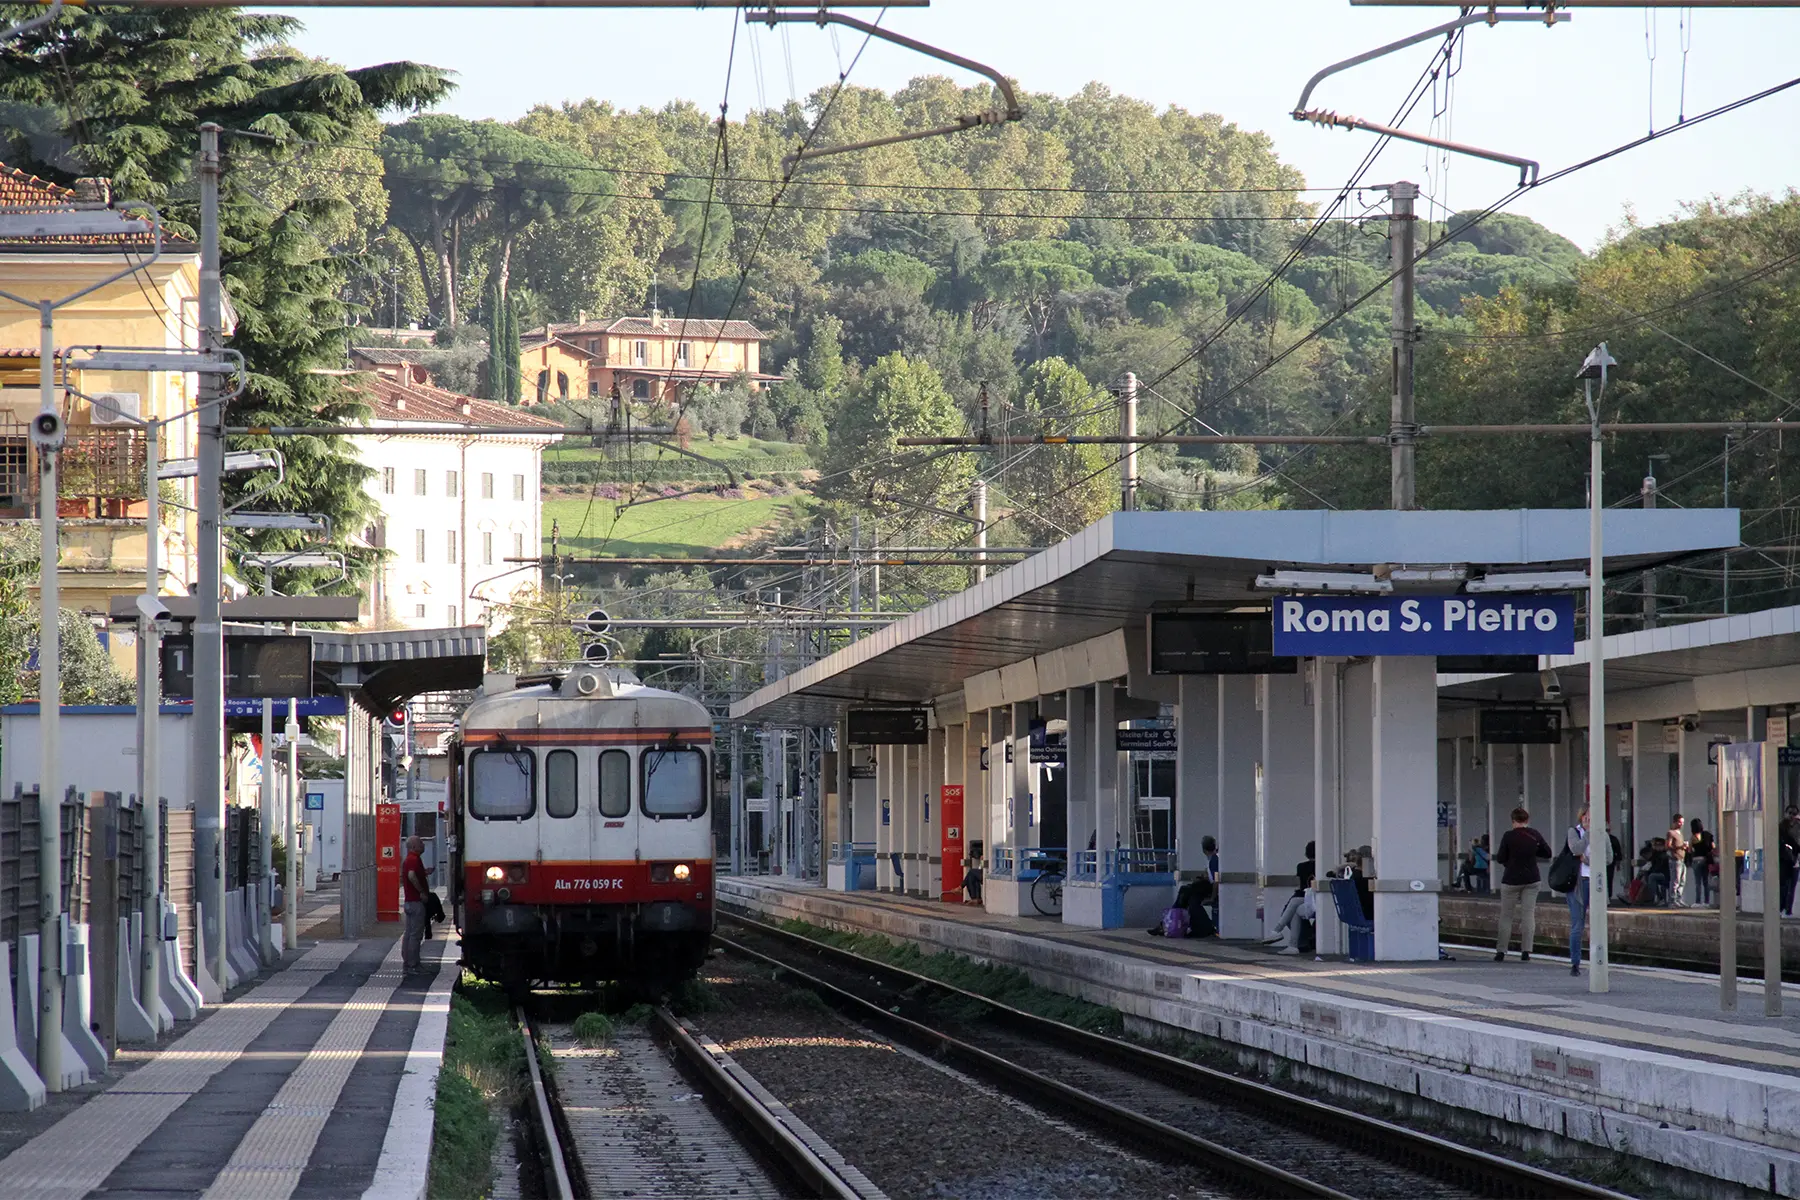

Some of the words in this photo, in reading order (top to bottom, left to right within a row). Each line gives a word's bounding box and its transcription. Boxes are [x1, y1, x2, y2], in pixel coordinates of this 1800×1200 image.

[1282, 601, 1390, 632] Roma
[1400, 600, 1432, 632] S.
[1444, 599, 1558, 632] Pietro
[173, 650, 184, 671] 1
[914, 719, 924, 731] 2
[944, 788, 961, 796] SOS
[380, 807, 396, 815] SOS
[554, 879, 571, 889] ALn
[573, 879, 591, 889] 776
[592, 879, 610, 889] 059
[612, 879, 623, 889] FC
